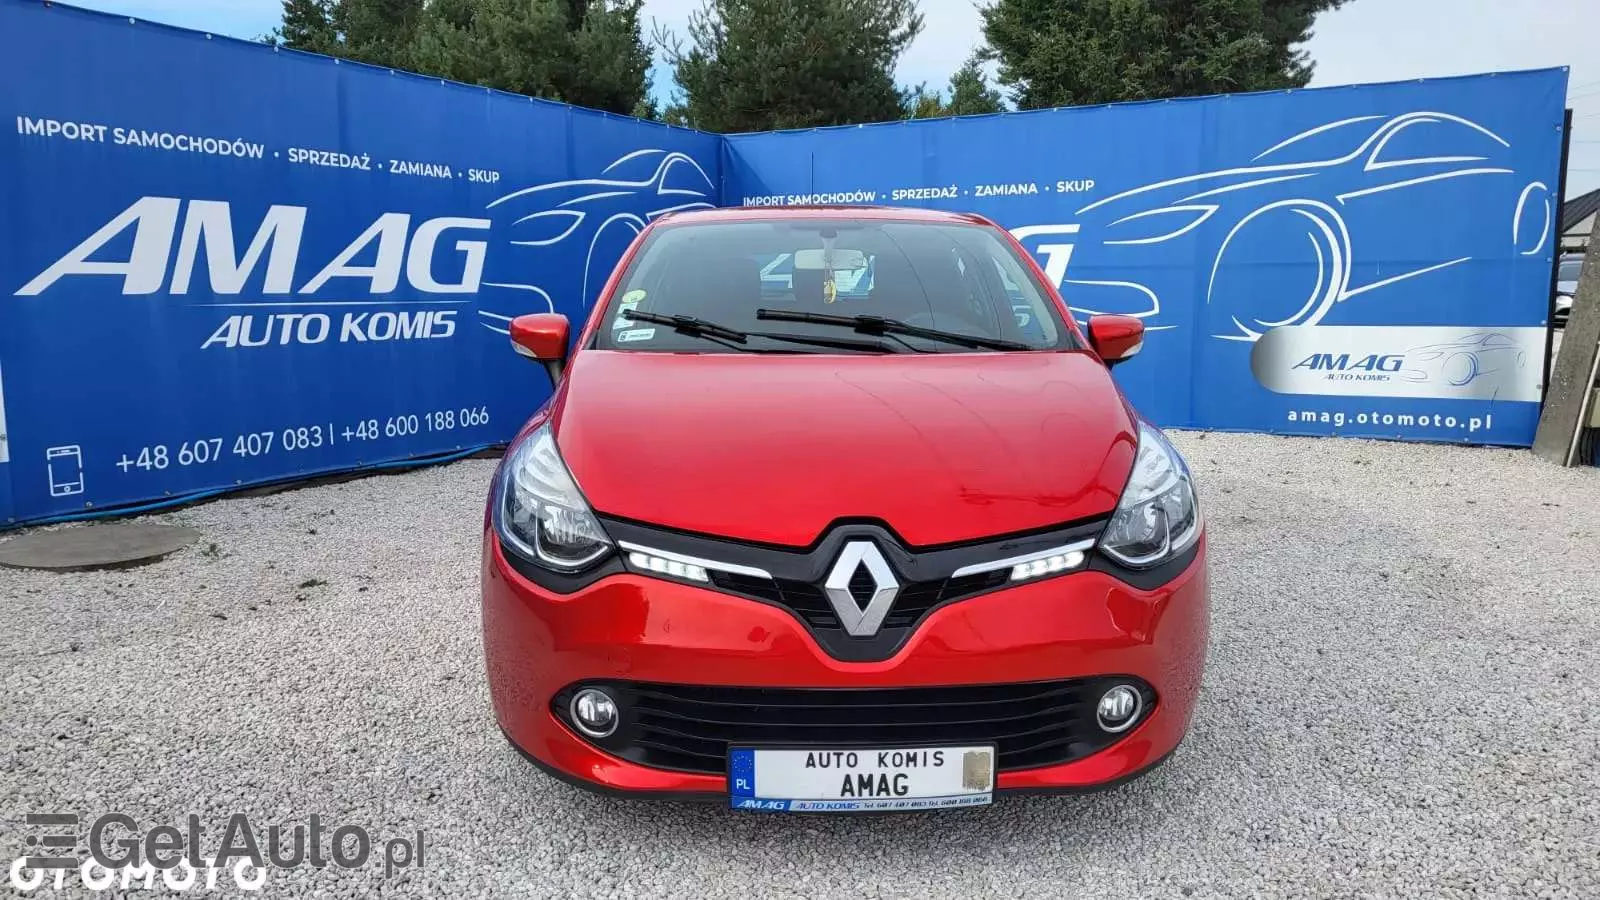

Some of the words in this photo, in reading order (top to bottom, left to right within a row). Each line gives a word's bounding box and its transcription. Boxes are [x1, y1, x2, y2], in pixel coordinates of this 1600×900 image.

[16, 116, 107, 142] IMPORT
[113, 127, 265, 159] SAMOCHODÓW
[288, 147, 371, 171] SPRZEDAŻ
[389, 159, 452, 179] ZAMIANA
[468, 168, 500, 183] SKUP
[743, 195, 786, 207] IMPORT
[787, 189, 876, 206] SAMOCHODÓW
[892, 184, 958, 200] SPRZEDAŻ
[975, 183, 1038, 197] ZAMIANA
[1056, 180, 1095, 193] SKUP
[200, 313, 330, 349] AUTO
[339, 310, 457, 342] KOMIS
[1324, 373, 1353, 381] AUTO
[1288, 410, 1492, 432] amag.otomoto.pl
[116, 445, 169, 473] +48
[178, 438, 223, 466] 607
[233, 431, 274, 457] 407
[282, 425, 323, 450] 083
[341, 419, 379, 442] +48
[385, 414, 418, 437] 600
[425, 410, 455, 432] 188
[460, 406, 489, 428] 066
[805, 752, 858, 769] AUTO
[878, 751, 945, 768] KOMIS
[736, 778, 750, 790] PL
[840, 773, 909, 797] AMAG
[796, 800, 825, 809] AUTO
